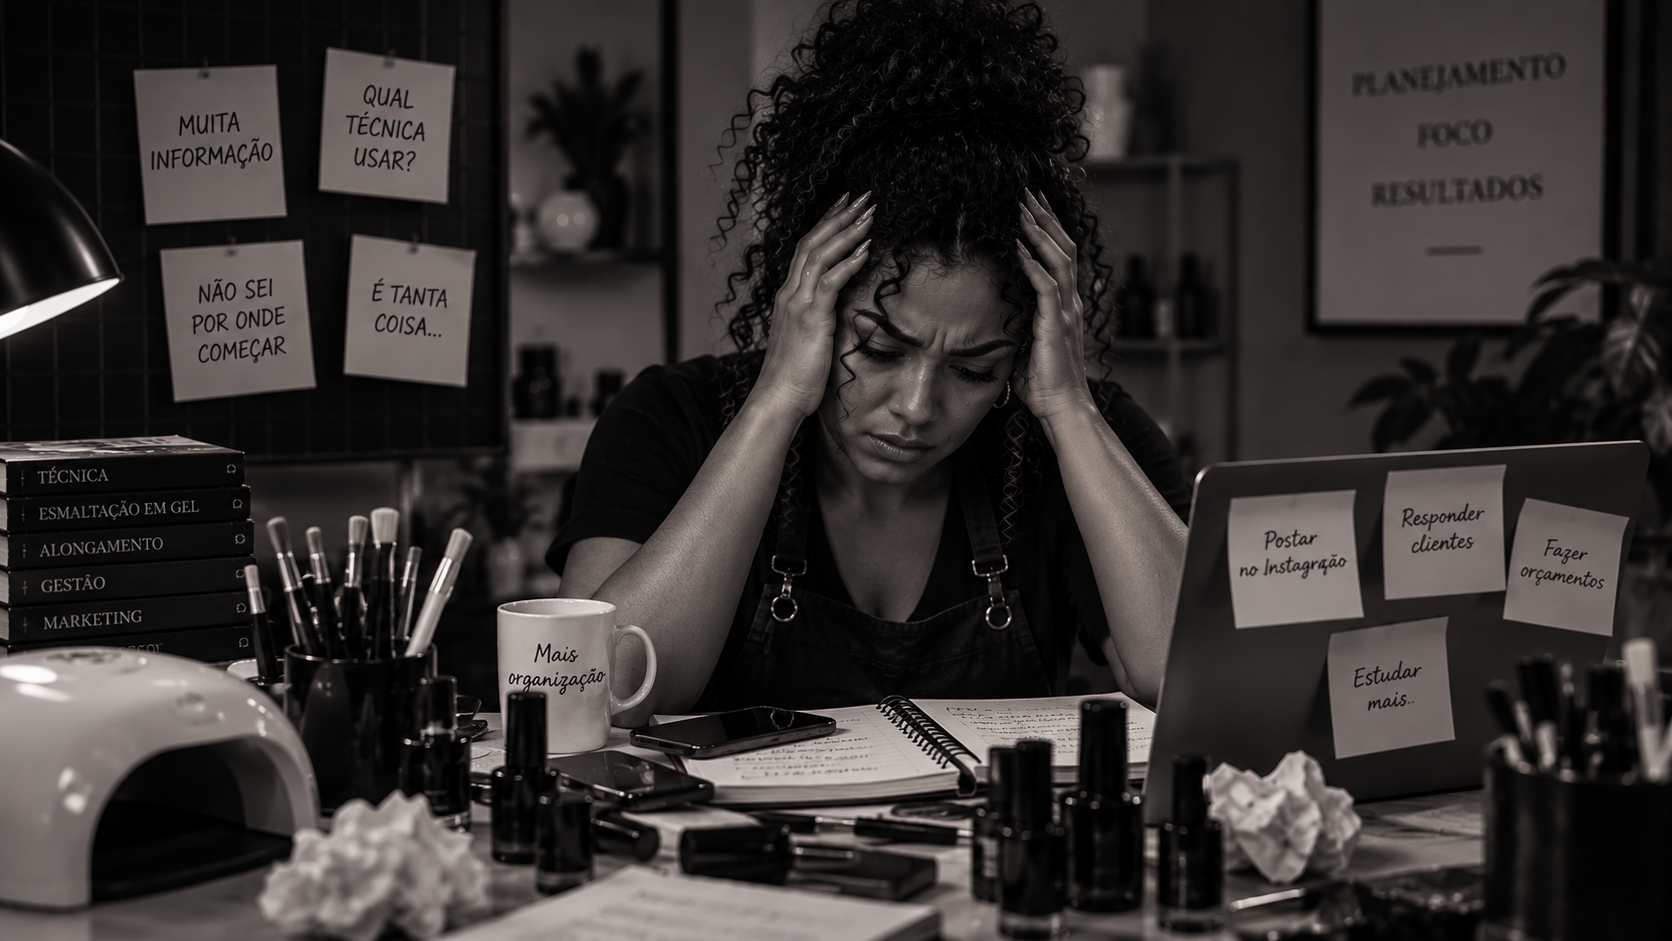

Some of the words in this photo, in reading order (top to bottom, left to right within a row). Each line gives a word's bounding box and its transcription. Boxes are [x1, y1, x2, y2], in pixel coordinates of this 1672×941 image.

[1352, 53, 1567, 96] PLANEJAMENTO
[363, 84, 414, 113] QUAL
[178, 111, 241, 137] MUITA
[346, 112, 426, 142] TÉCNICA
[1417, 118, 1494, 148] FOCO
[150, 138, 274, 170] INFORMAÇÃO
[353, 147, 417, 172] USAR?
[1371, 173, 1545, 208] RESULTADOS
[198, 278, 237, 305] NÃO
[245, 278, 273, 300] SEI
[371, 278, 385, 302] É
[390, 285, 448, 309] TANTA
[191, 313, 230, 335] POR
[235, 306, 286, 330] ONDE
[374, 313, 442, 338] COISA...
[197, 336, 287, 364] COMEÇAR
[37, 466, 109, 485] TÉCNICA
[144, 502, 167, 515] EM
[170, 500, 200, 514] GEL
[1401, 502, 1485, 531] Responder
[39, 537, 164, 558] ALONGAMENTO
[1264, 529, 1318, 550] Postar
[1411, 533, 1474, 554] clientes
[1543, 538, 1589, 564] Fazer
[1239, 565, 1259, 578] no
[1520, 565, 1606, 590] orçamentos
[43, 609, 142, 630] MARKETING
[533, 642, 579, 663] Mais
[507, 668, 606, 695] organização
[1352, 661, 1423, 689] Estudar
